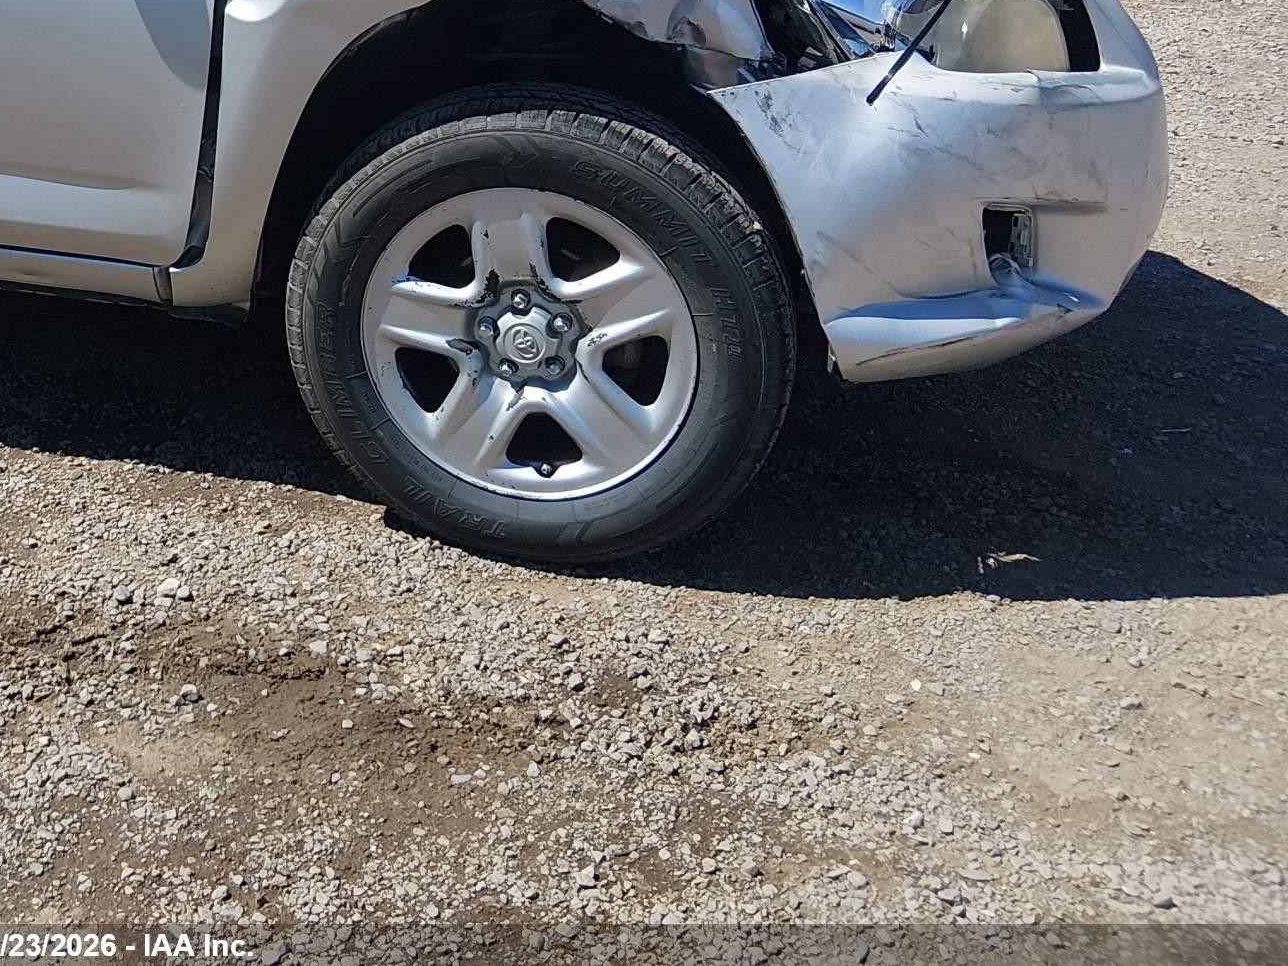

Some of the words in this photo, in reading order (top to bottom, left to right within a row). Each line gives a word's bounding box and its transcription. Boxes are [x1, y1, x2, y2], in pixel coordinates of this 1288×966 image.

[573, 160, 714, 266] SUMMIT
[317, 301, 389, 463] CLIMBER
[400, 475, 507, 540] TRAIL
